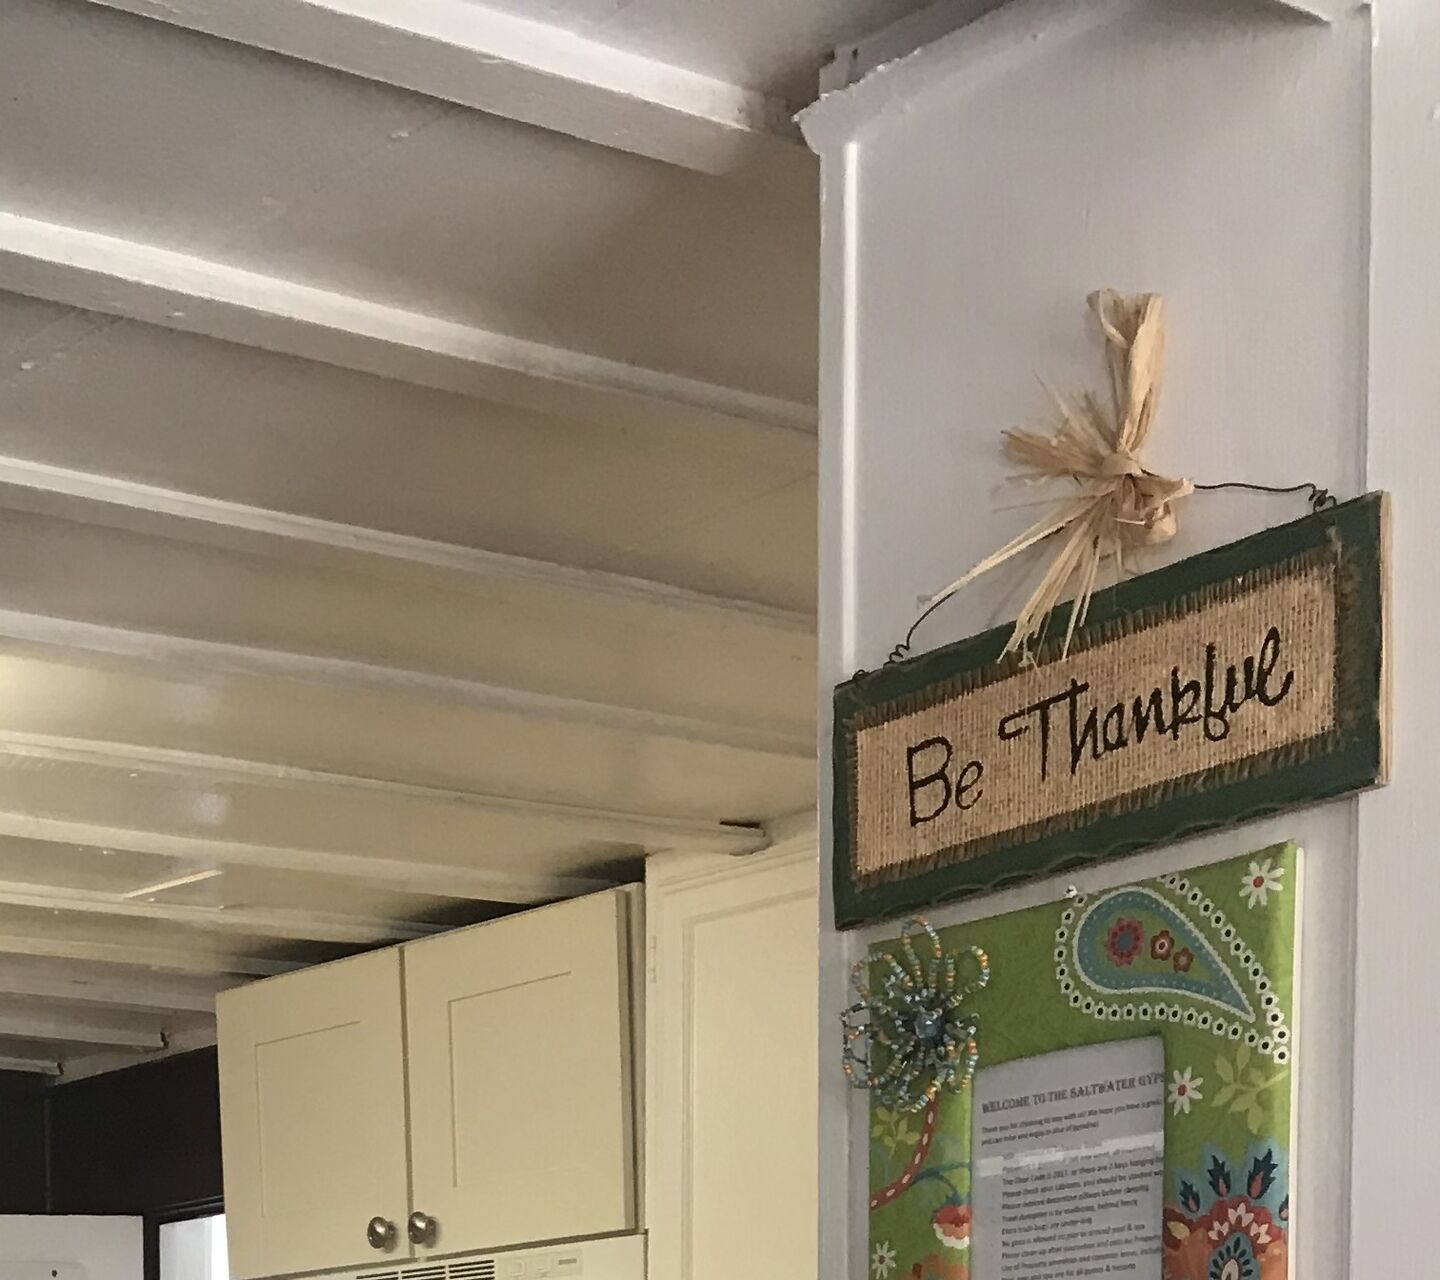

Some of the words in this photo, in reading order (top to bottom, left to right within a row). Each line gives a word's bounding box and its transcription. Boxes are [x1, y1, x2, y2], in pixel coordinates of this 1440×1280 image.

[906, 736, 984, 828] Be
[997, 626, 1295, 781] Thankful
[981, 1096, 1030, 1114] WELCOME
[1032, 1092, 1045, 1106] TO
[1047, 1088, 1068, 1103] THE
[1070, 1076, 1136, 1099] SALTWATER
